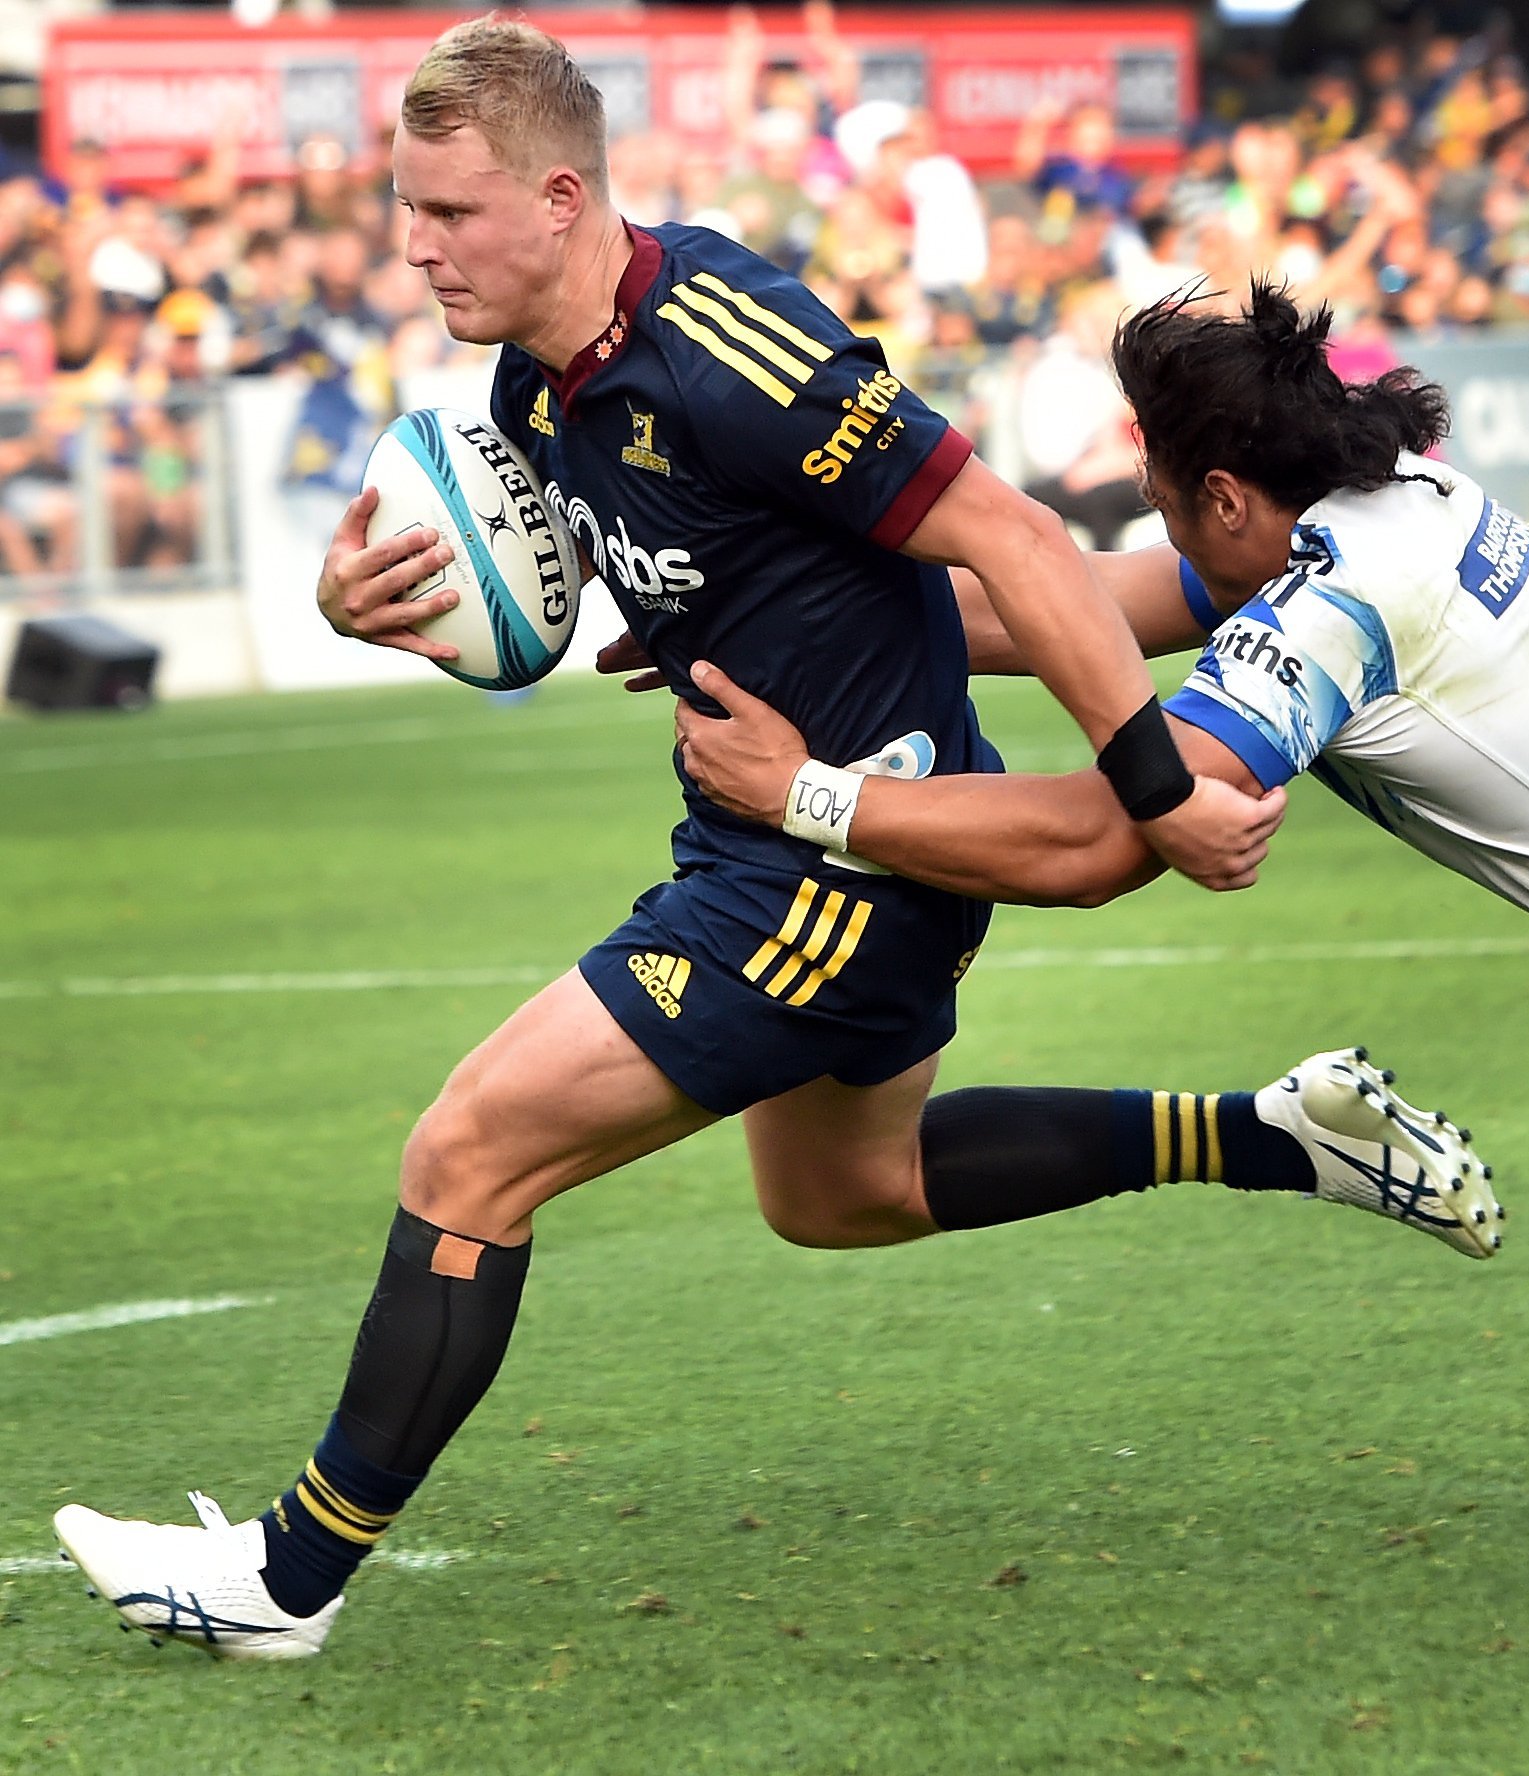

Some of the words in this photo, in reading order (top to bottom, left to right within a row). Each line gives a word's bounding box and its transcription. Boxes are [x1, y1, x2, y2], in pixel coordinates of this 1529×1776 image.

[802, 369, 901, 484] Smiths
[877, 416, 905, 450] CITY
[452, 423, 569, 626] GILBERT
[606, 515, 705, 595] sbs
[628, 953, 681, 1019] adidas
